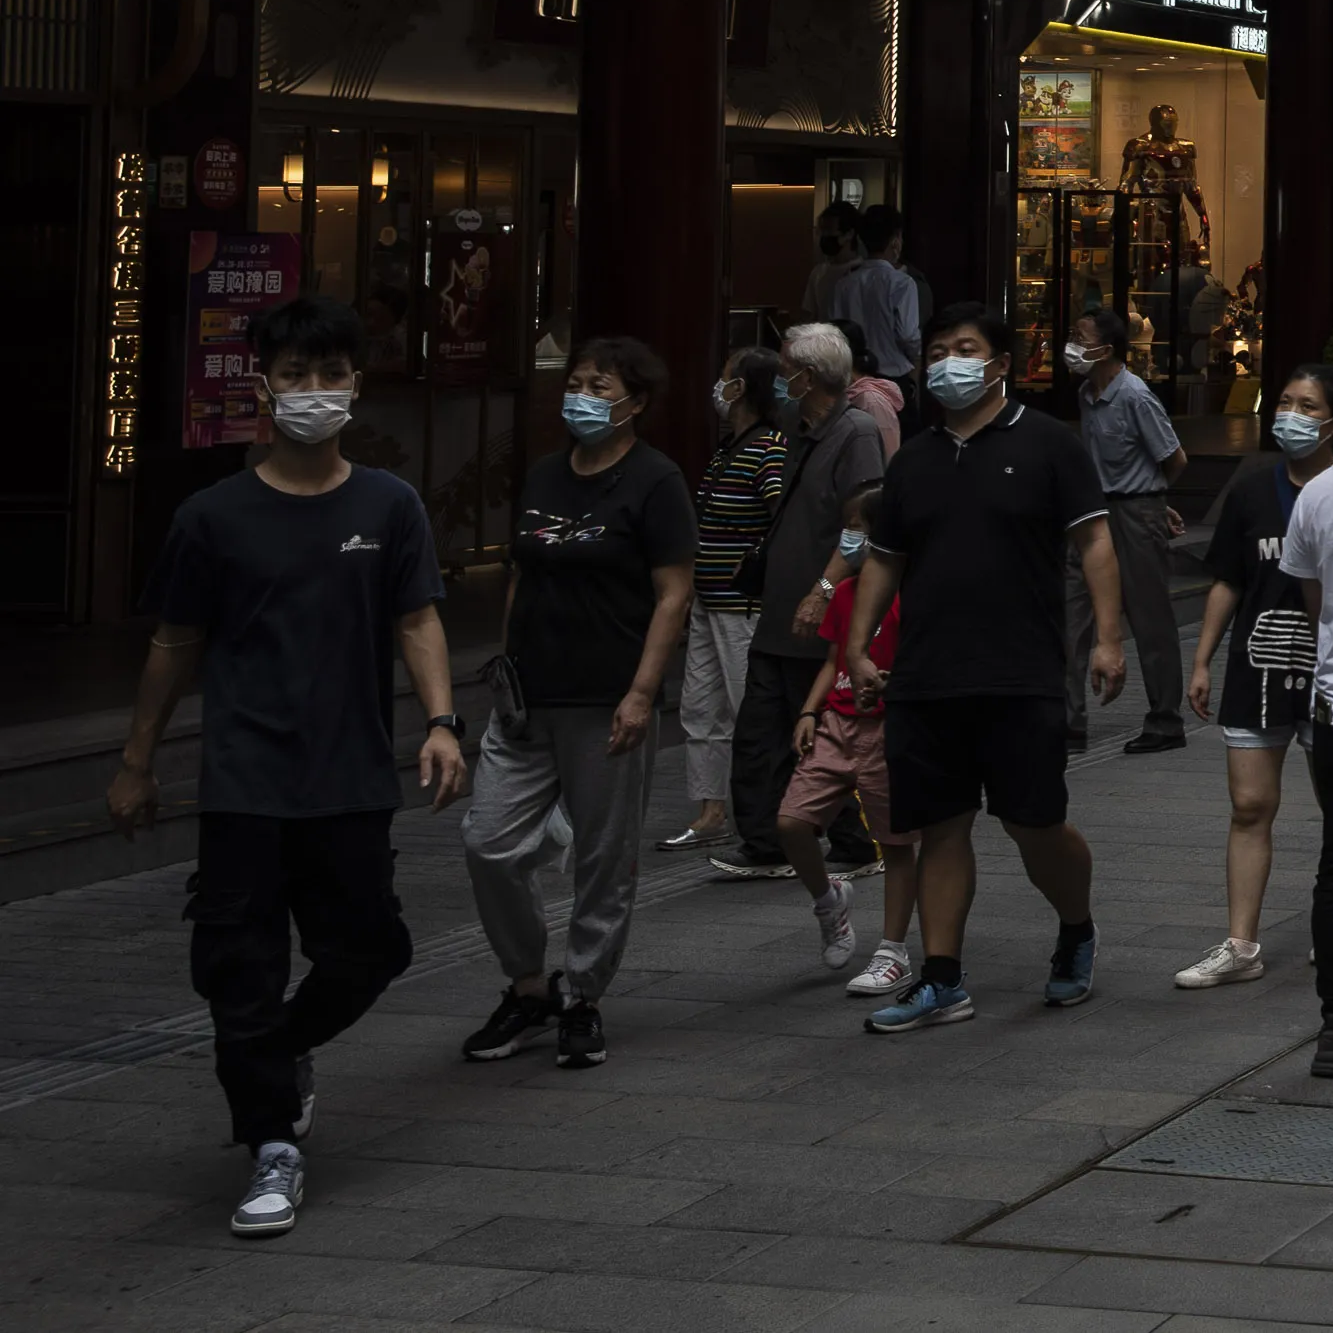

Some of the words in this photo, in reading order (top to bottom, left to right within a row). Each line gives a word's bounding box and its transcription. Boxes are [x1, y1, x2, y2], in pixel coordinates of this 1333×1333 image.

[207, 270, 282, 294] 爱购豫园
[204, 354, 261, 378] 爱购上
[1258, 537, 1284, 561] M
